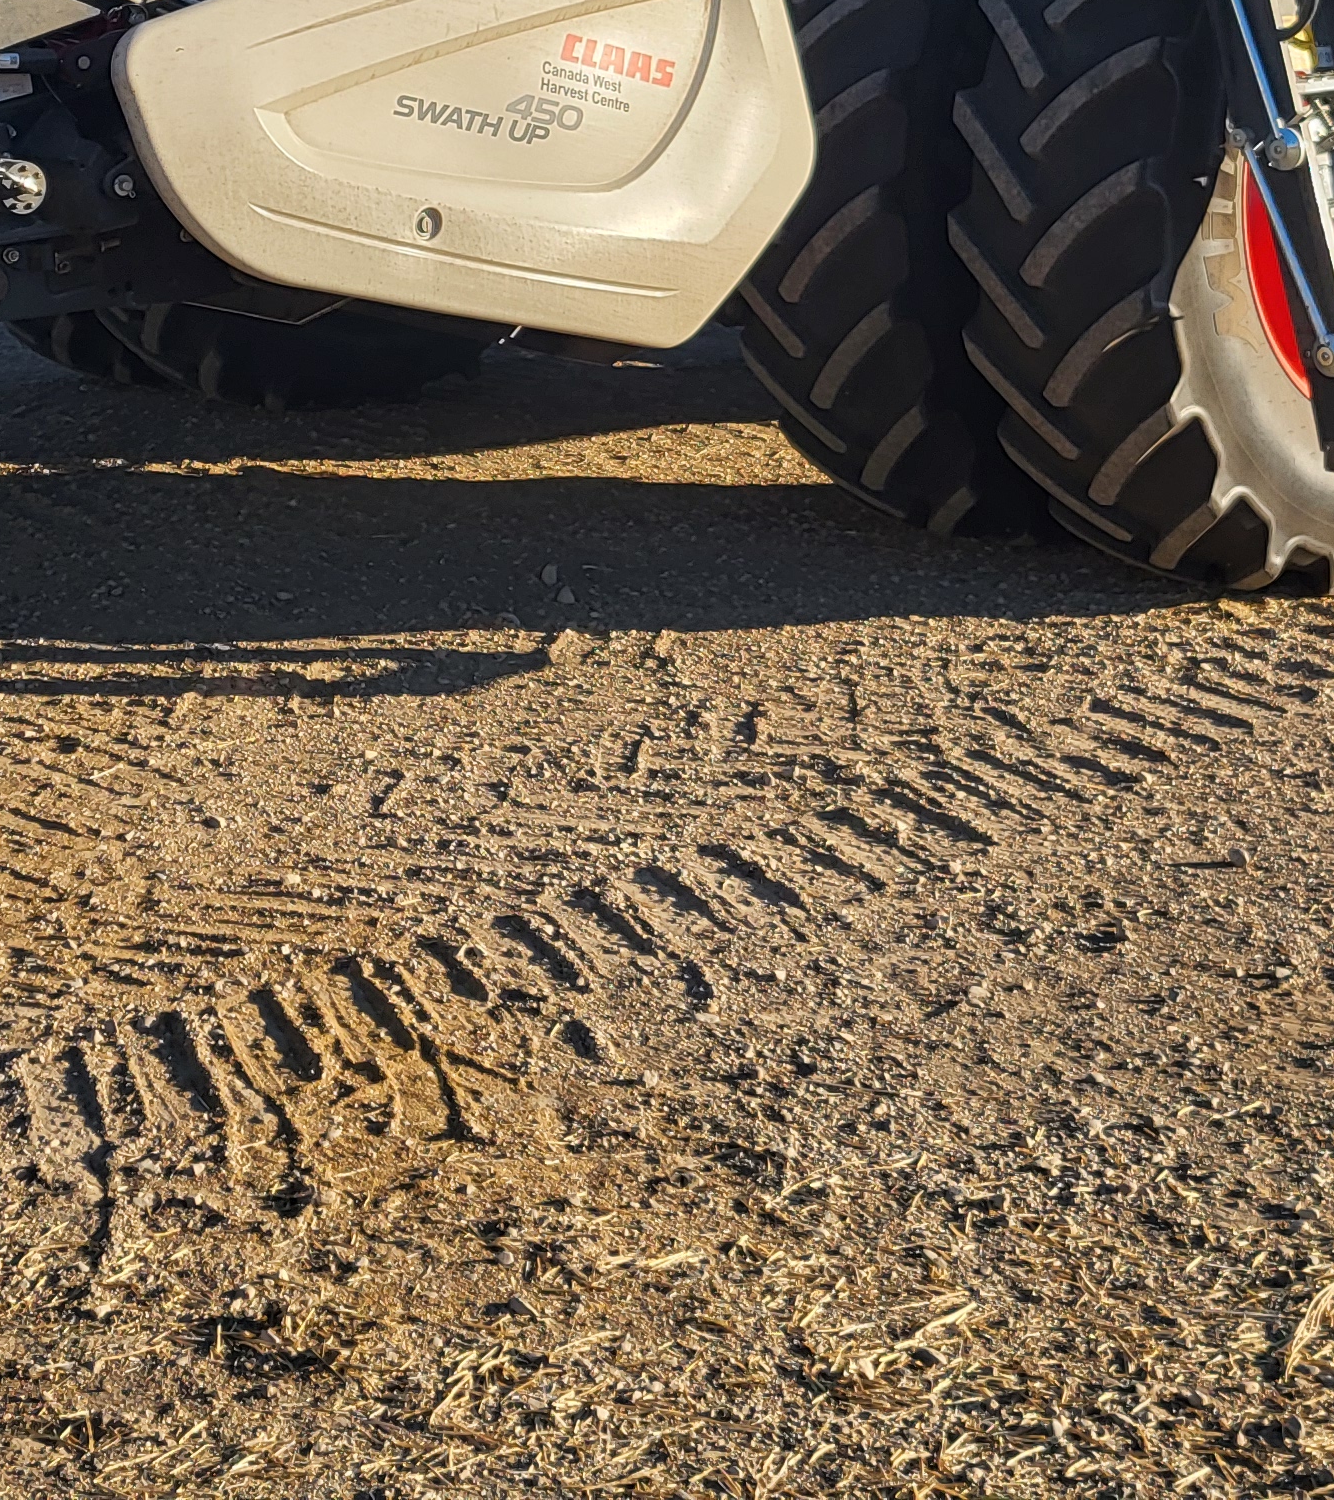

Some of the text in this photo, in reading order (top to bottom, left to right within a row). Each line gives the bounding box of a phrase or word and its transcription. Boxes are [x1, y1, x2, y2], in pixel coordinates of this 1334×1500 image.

[541, 60, 622, 94] Canada West
[560, 32, 676, 89] CLAAS
[505, 94, 584, 132] 450
[540, 76, 630, 113] Harvest Centre
[393, 94, 551, 146] SWATH UP
